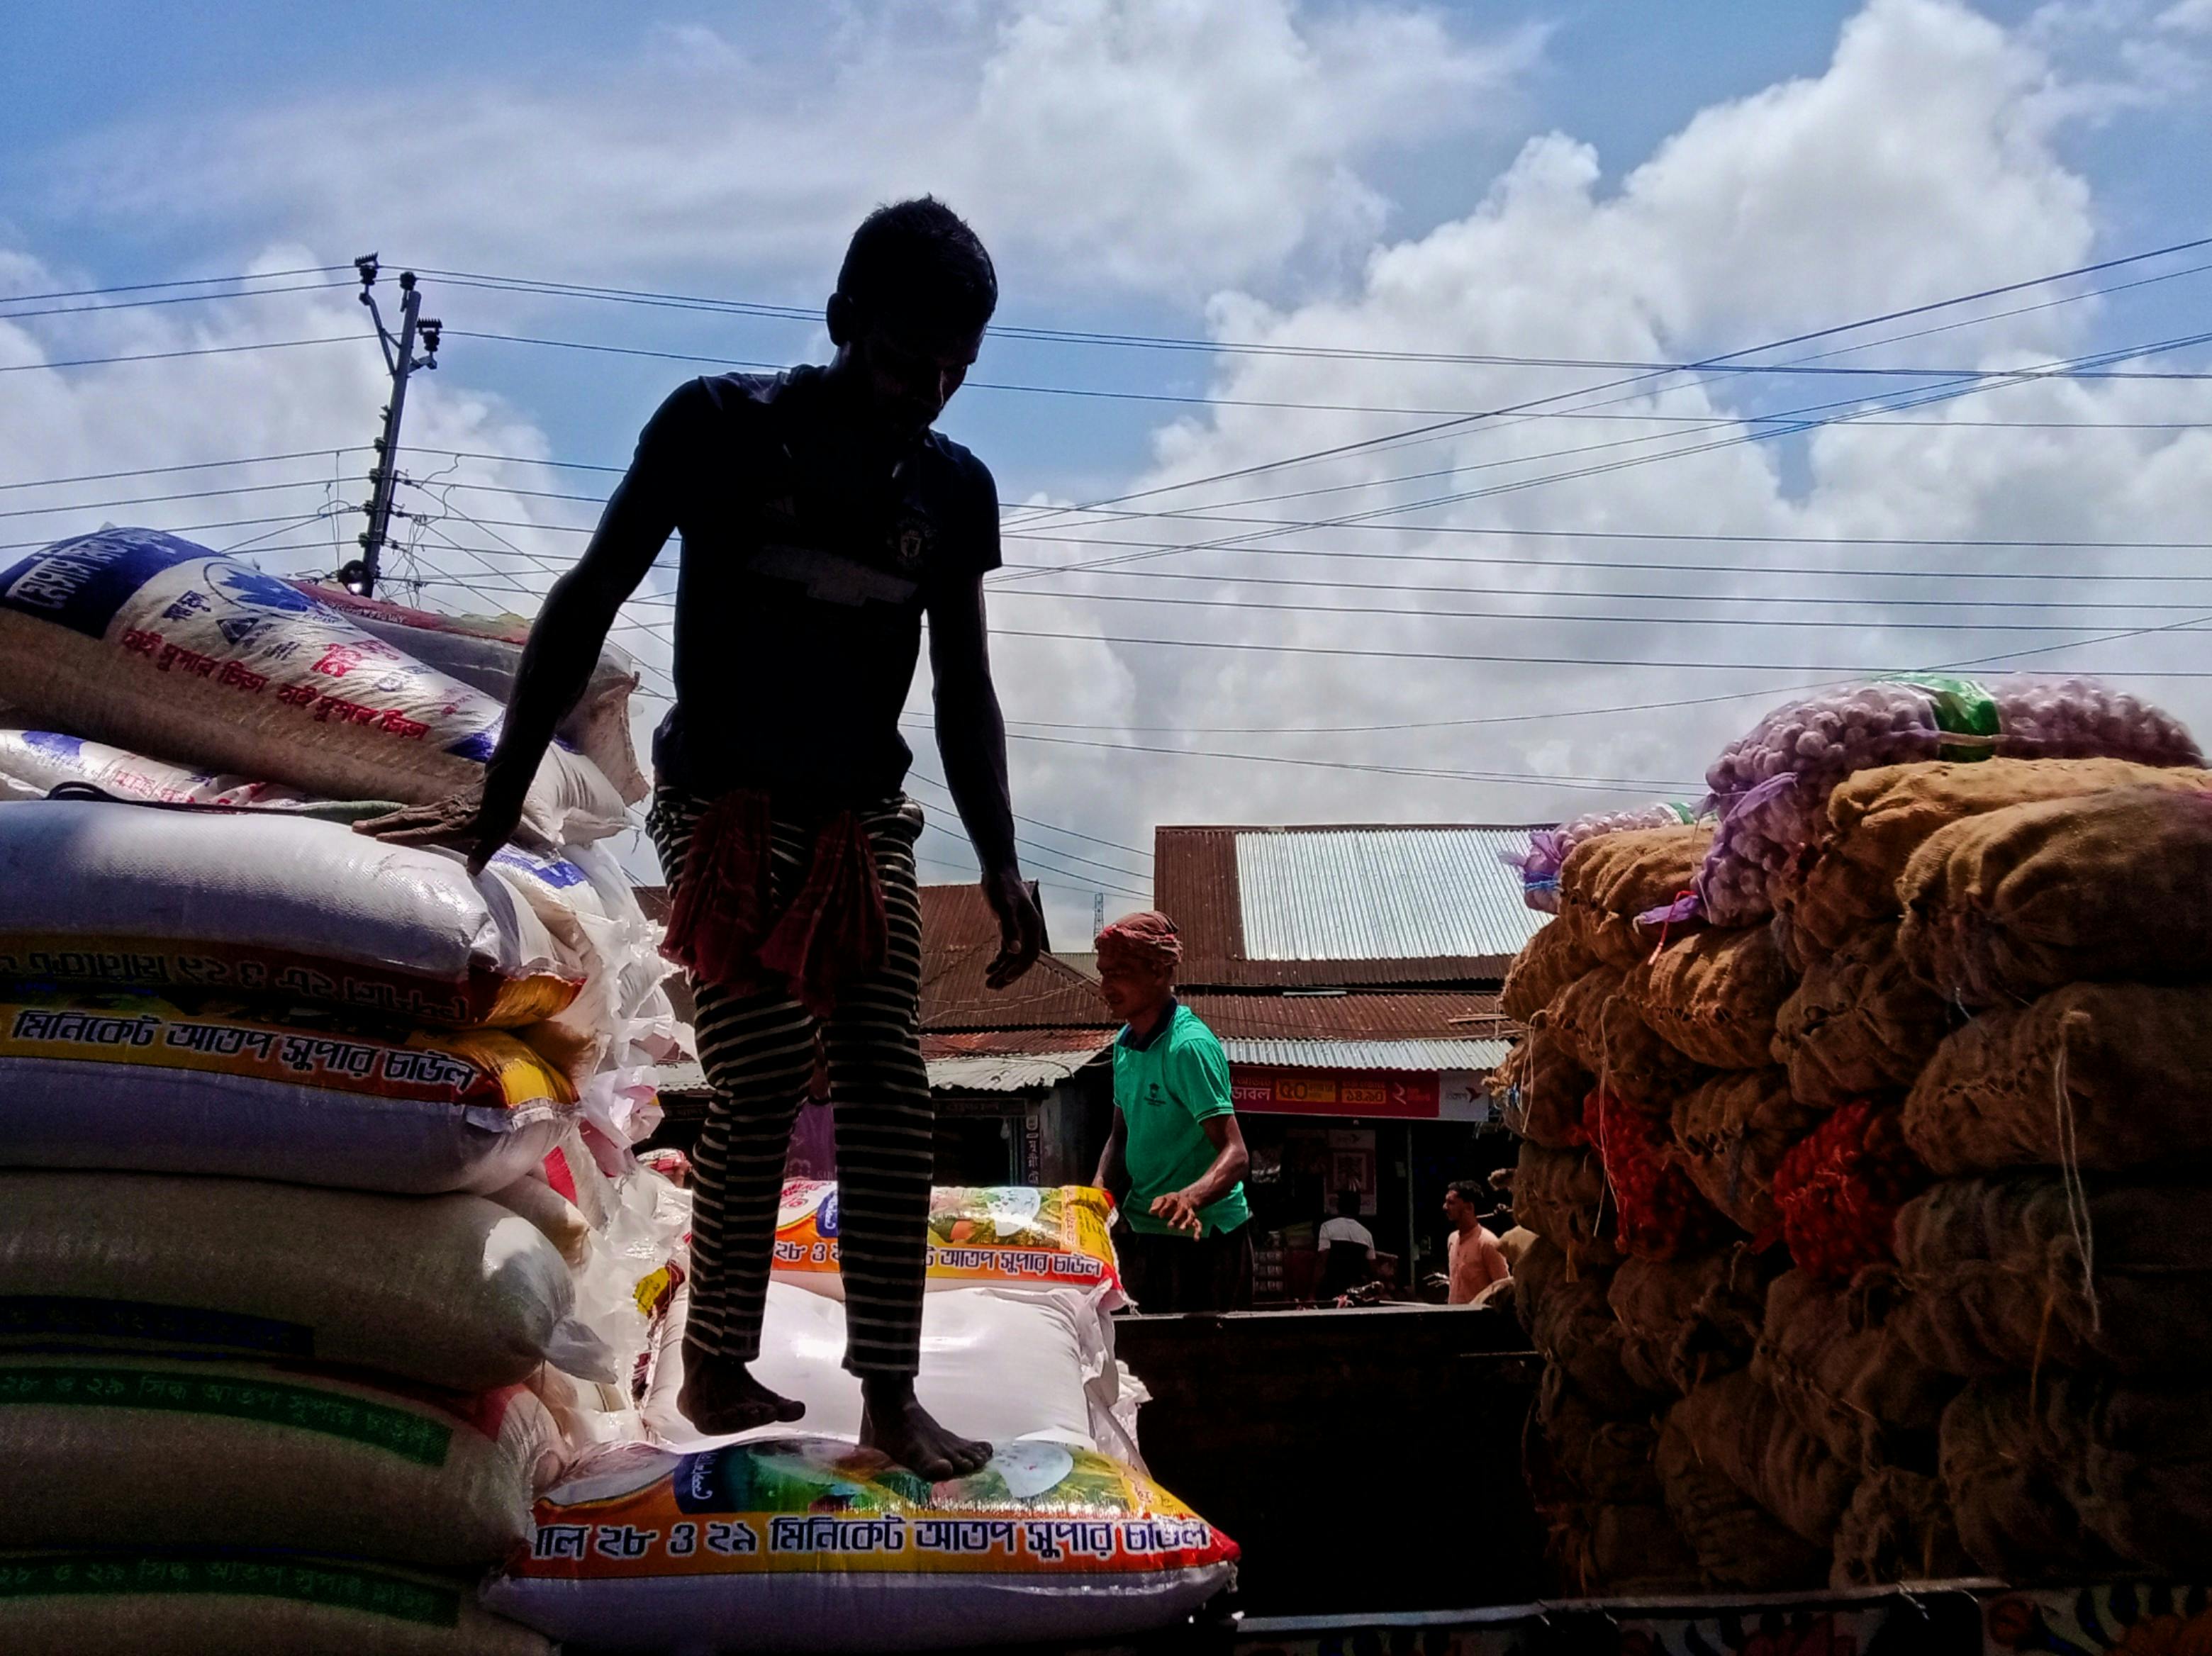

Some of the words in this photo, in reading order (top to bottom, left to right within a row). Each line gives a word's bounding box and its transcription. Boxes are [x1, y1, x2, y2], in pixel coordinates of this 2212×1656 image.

[13, 1009, 162, 1046] মিনিকেট
[167, 1022, 279, 1059] আতপ
[281, 1036, 378, 1078] সুপার
[383, 1048, 476, 1092] চাউল
[775, 1242, 806, 1260] ২৮
[812, 1243, 825, 1262] ও
[940, 1249, 995, 1270] আতপ
[1000, 1251, 1048, 1275] সুপার
[1053, 1251, 1101, 1276] চাউল
[599, 1525, 659, 1557] ২৮
[669, 1523, 697, 1555] ও
[706, 1521, 757, 1552] ২৯
[770, 1515, 906, 1551] মিনিকেট
[915, 1520, 1017, 1552] আতপ
[1025, 1521, 1114, 1558] সুপার
[1122, 1517, 1210, 1551] চাউল
